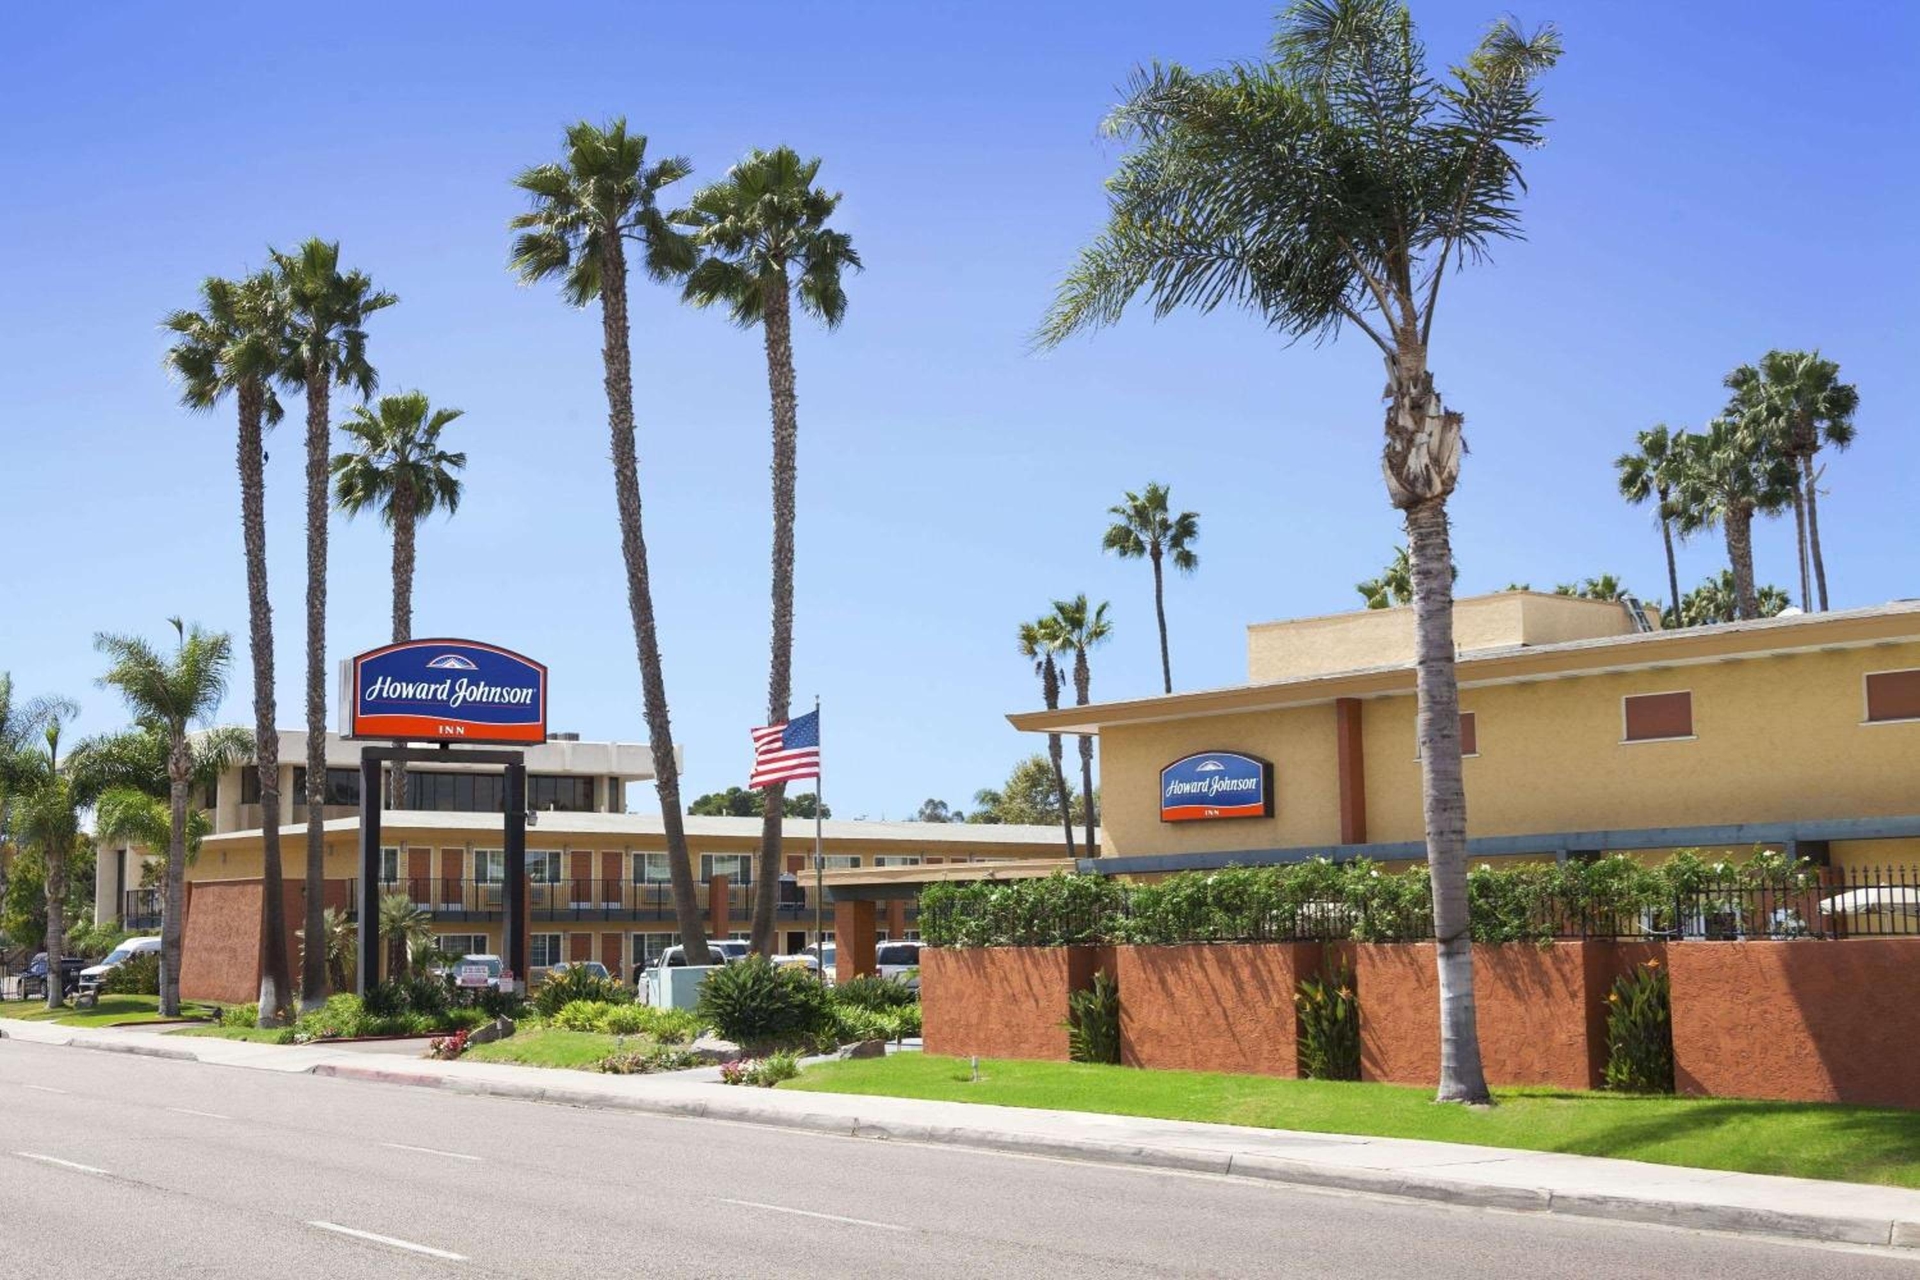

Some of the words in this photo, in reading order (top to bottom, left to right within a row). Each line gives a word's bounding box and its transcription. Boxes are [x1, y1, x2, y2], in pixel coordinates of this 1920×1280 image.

[366, 676, 450, 700] Howard
[450, 678, 531, 707] Johnson
[439, 725, 465, 735] INN
[1166, 779, 1209, 797] Howard
[1209, 775, 1256, 796] Johnson
